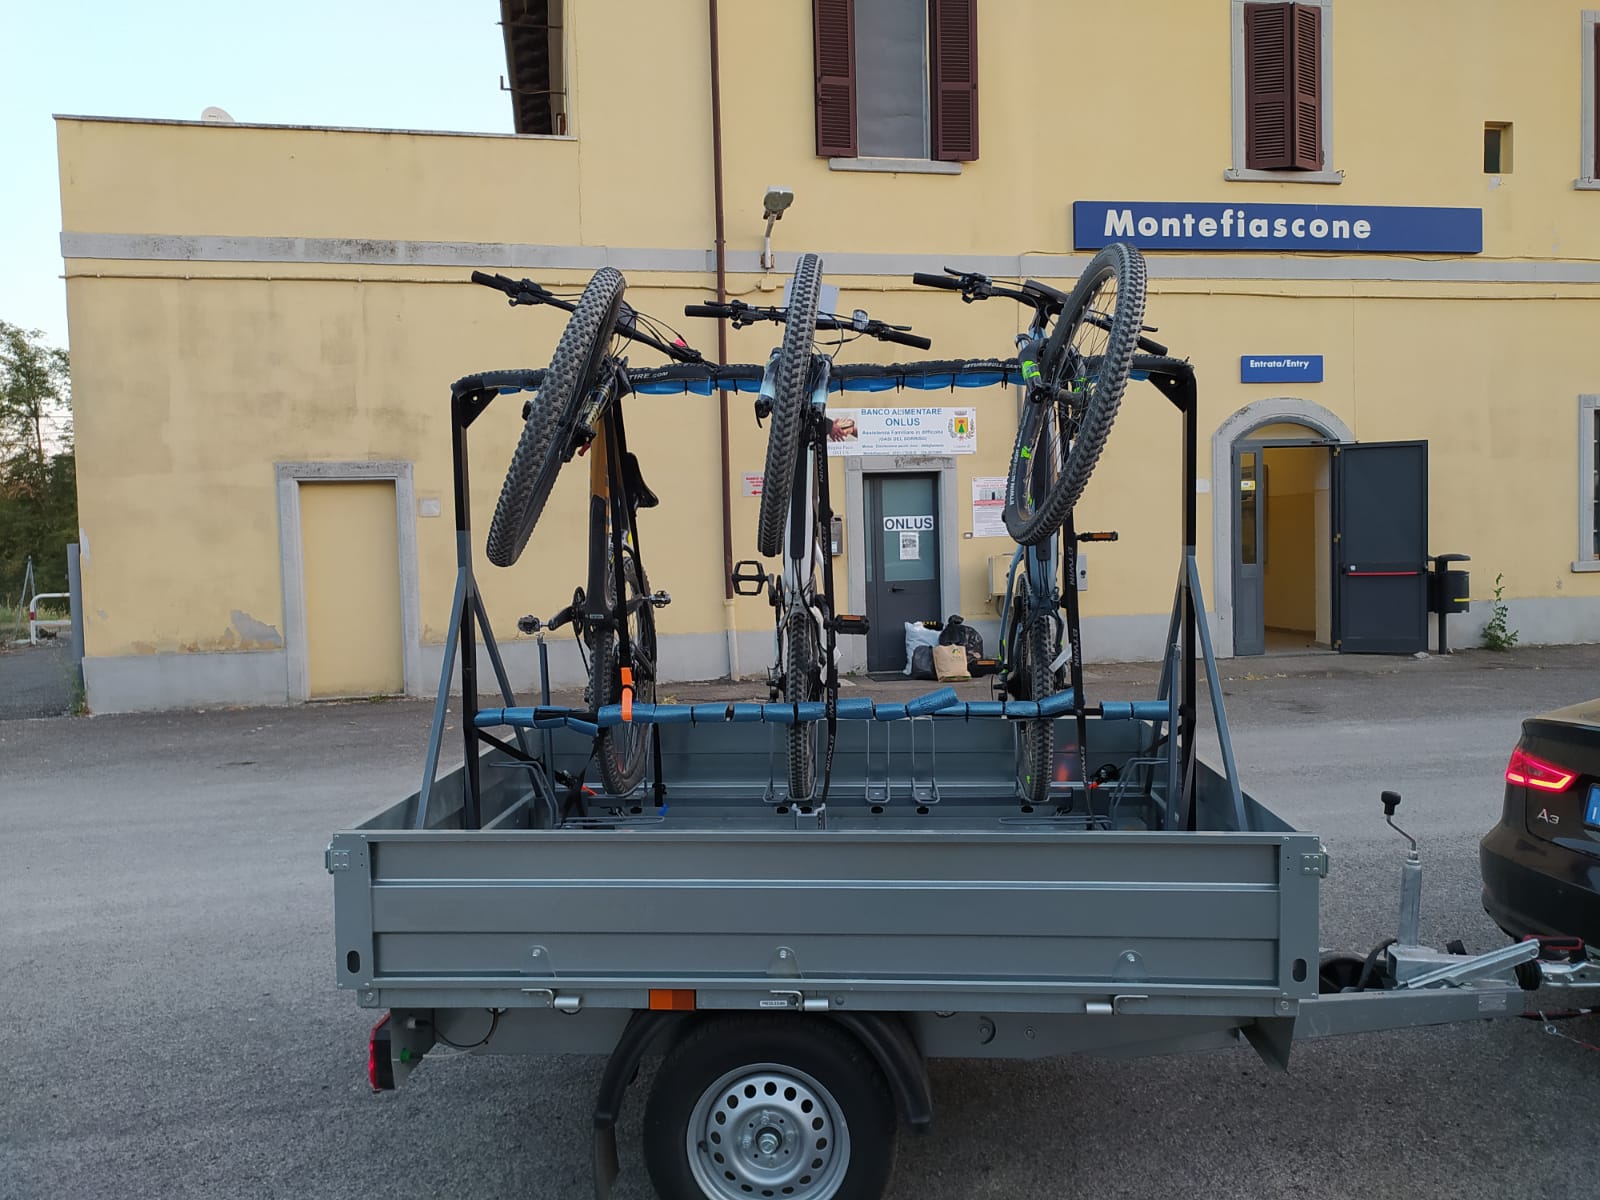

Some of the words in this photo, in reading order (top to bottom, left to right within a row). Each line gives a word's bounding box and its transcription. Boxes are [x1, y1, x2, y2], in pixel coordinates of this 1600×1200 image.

[1104, 209, 1371, 239] Montefiascone
[1249, 359, 1310, 370] Entrata/Entry
[861, 408, 890, 416] BANCO
[891, 408, 943, 416] ALIMENTARE
[885, 417, 921, 427] ONLUS
[885, 518, 933, 529] ONLUS
[1536, 808, 1560, 824] A3
